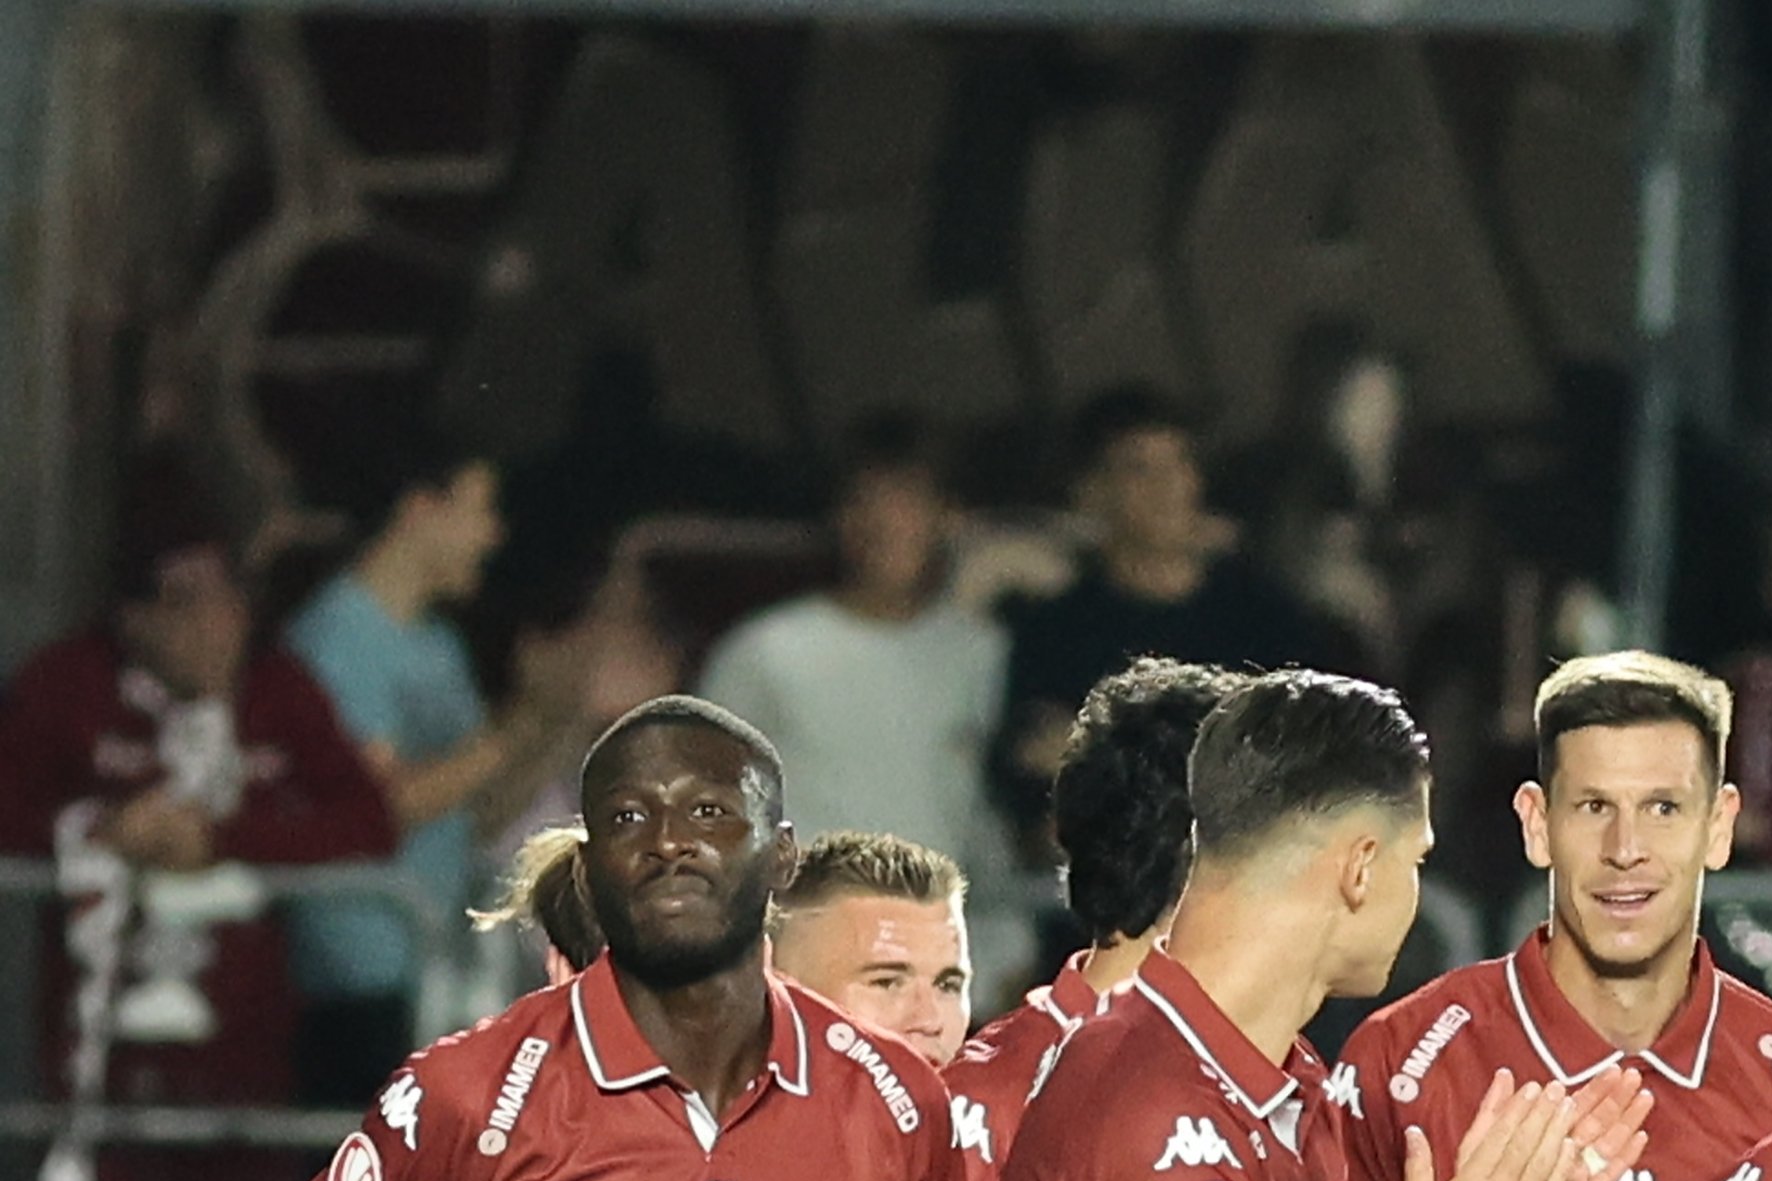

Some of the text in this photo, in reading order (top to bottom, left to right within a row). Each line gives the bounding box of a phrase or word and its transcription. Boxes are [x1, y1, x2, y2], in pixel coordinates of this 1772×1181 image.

[489, 1037, 549, 1131] IMAMED
[846, 1038, 919, 1133] IMAMED
[1402, 1004, 1471, 1079] IMAMED
